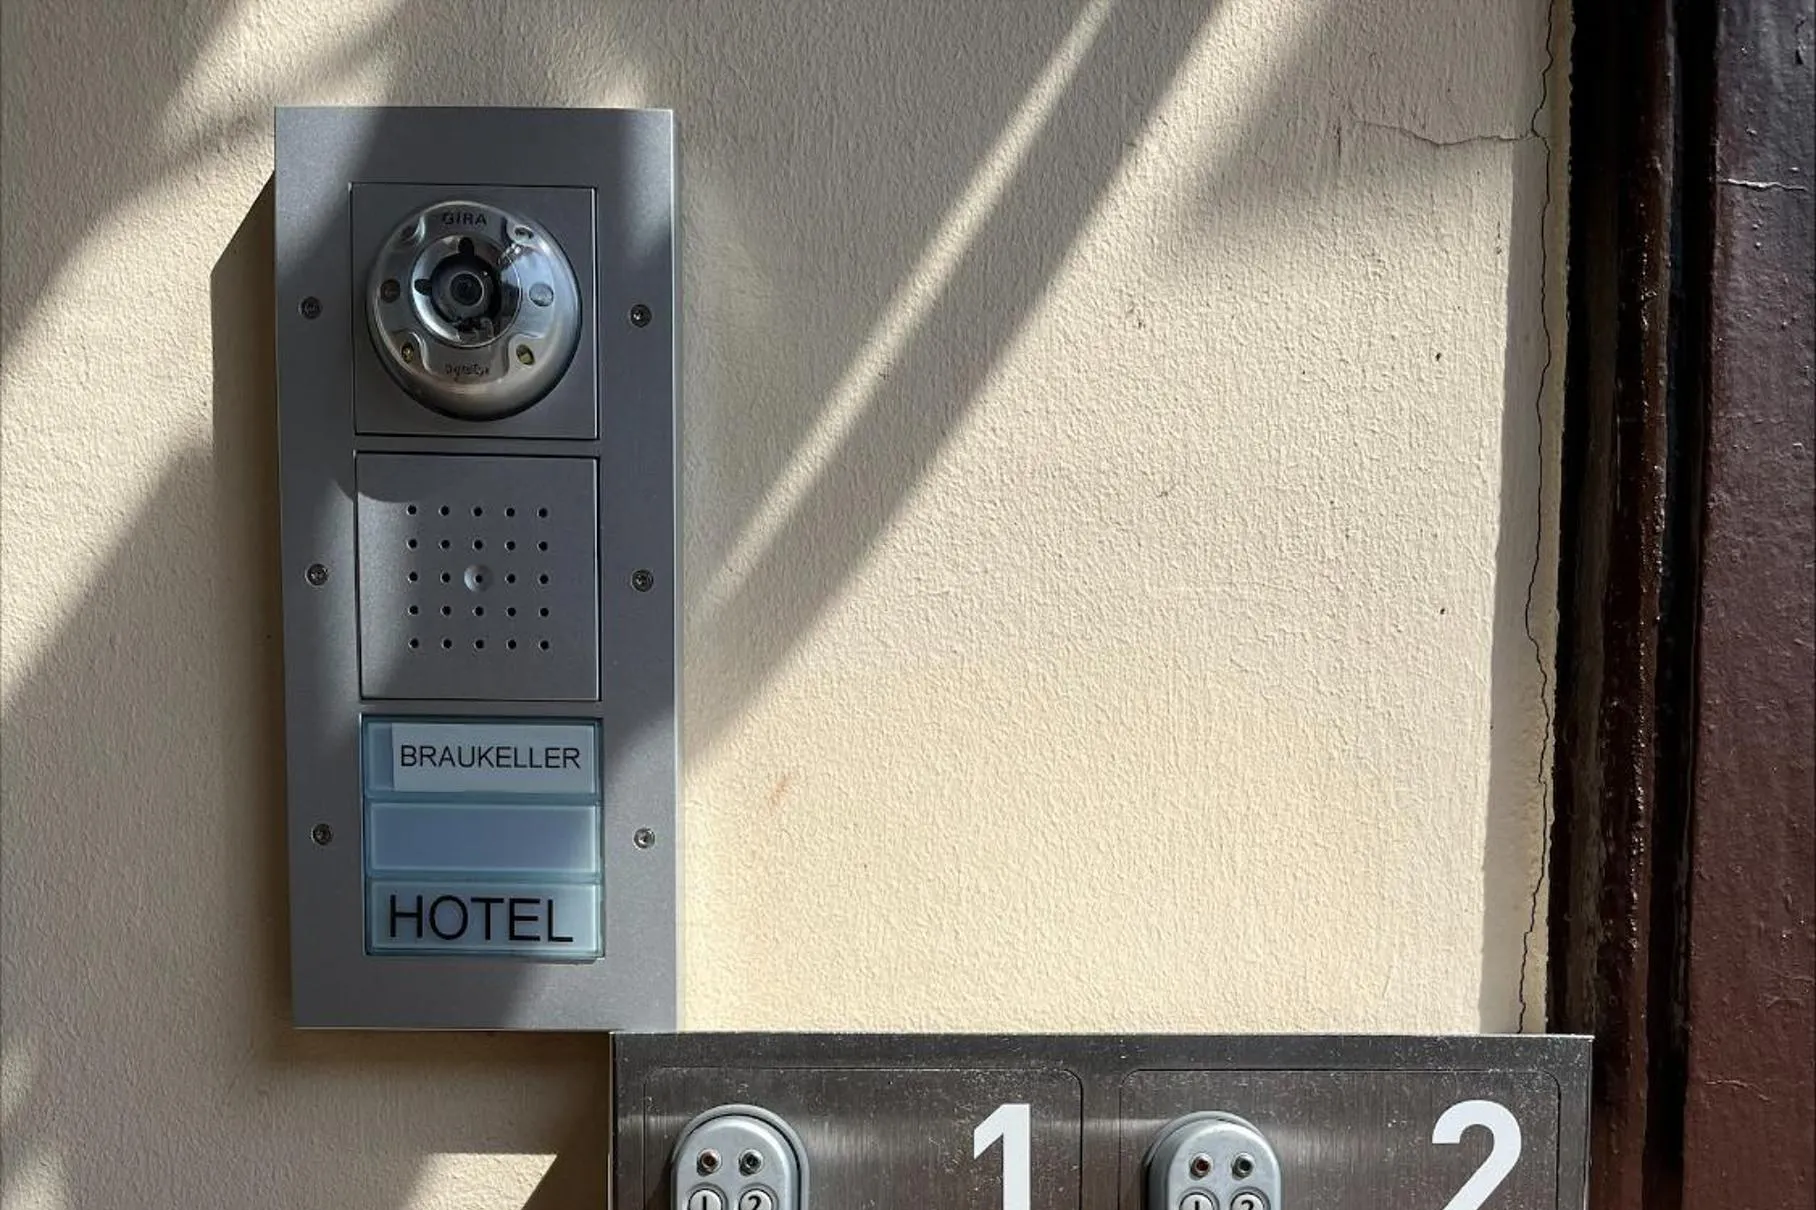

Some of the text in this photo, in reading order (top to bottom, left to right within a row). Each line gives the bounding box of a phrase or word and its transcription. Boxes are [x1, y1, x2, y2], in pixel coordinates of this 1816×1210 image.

[442, 212, 488, 226] GIRA
[400, 744, 582, 770] BRAUKELLER
[389, 894, 574, 943] HOTEL
